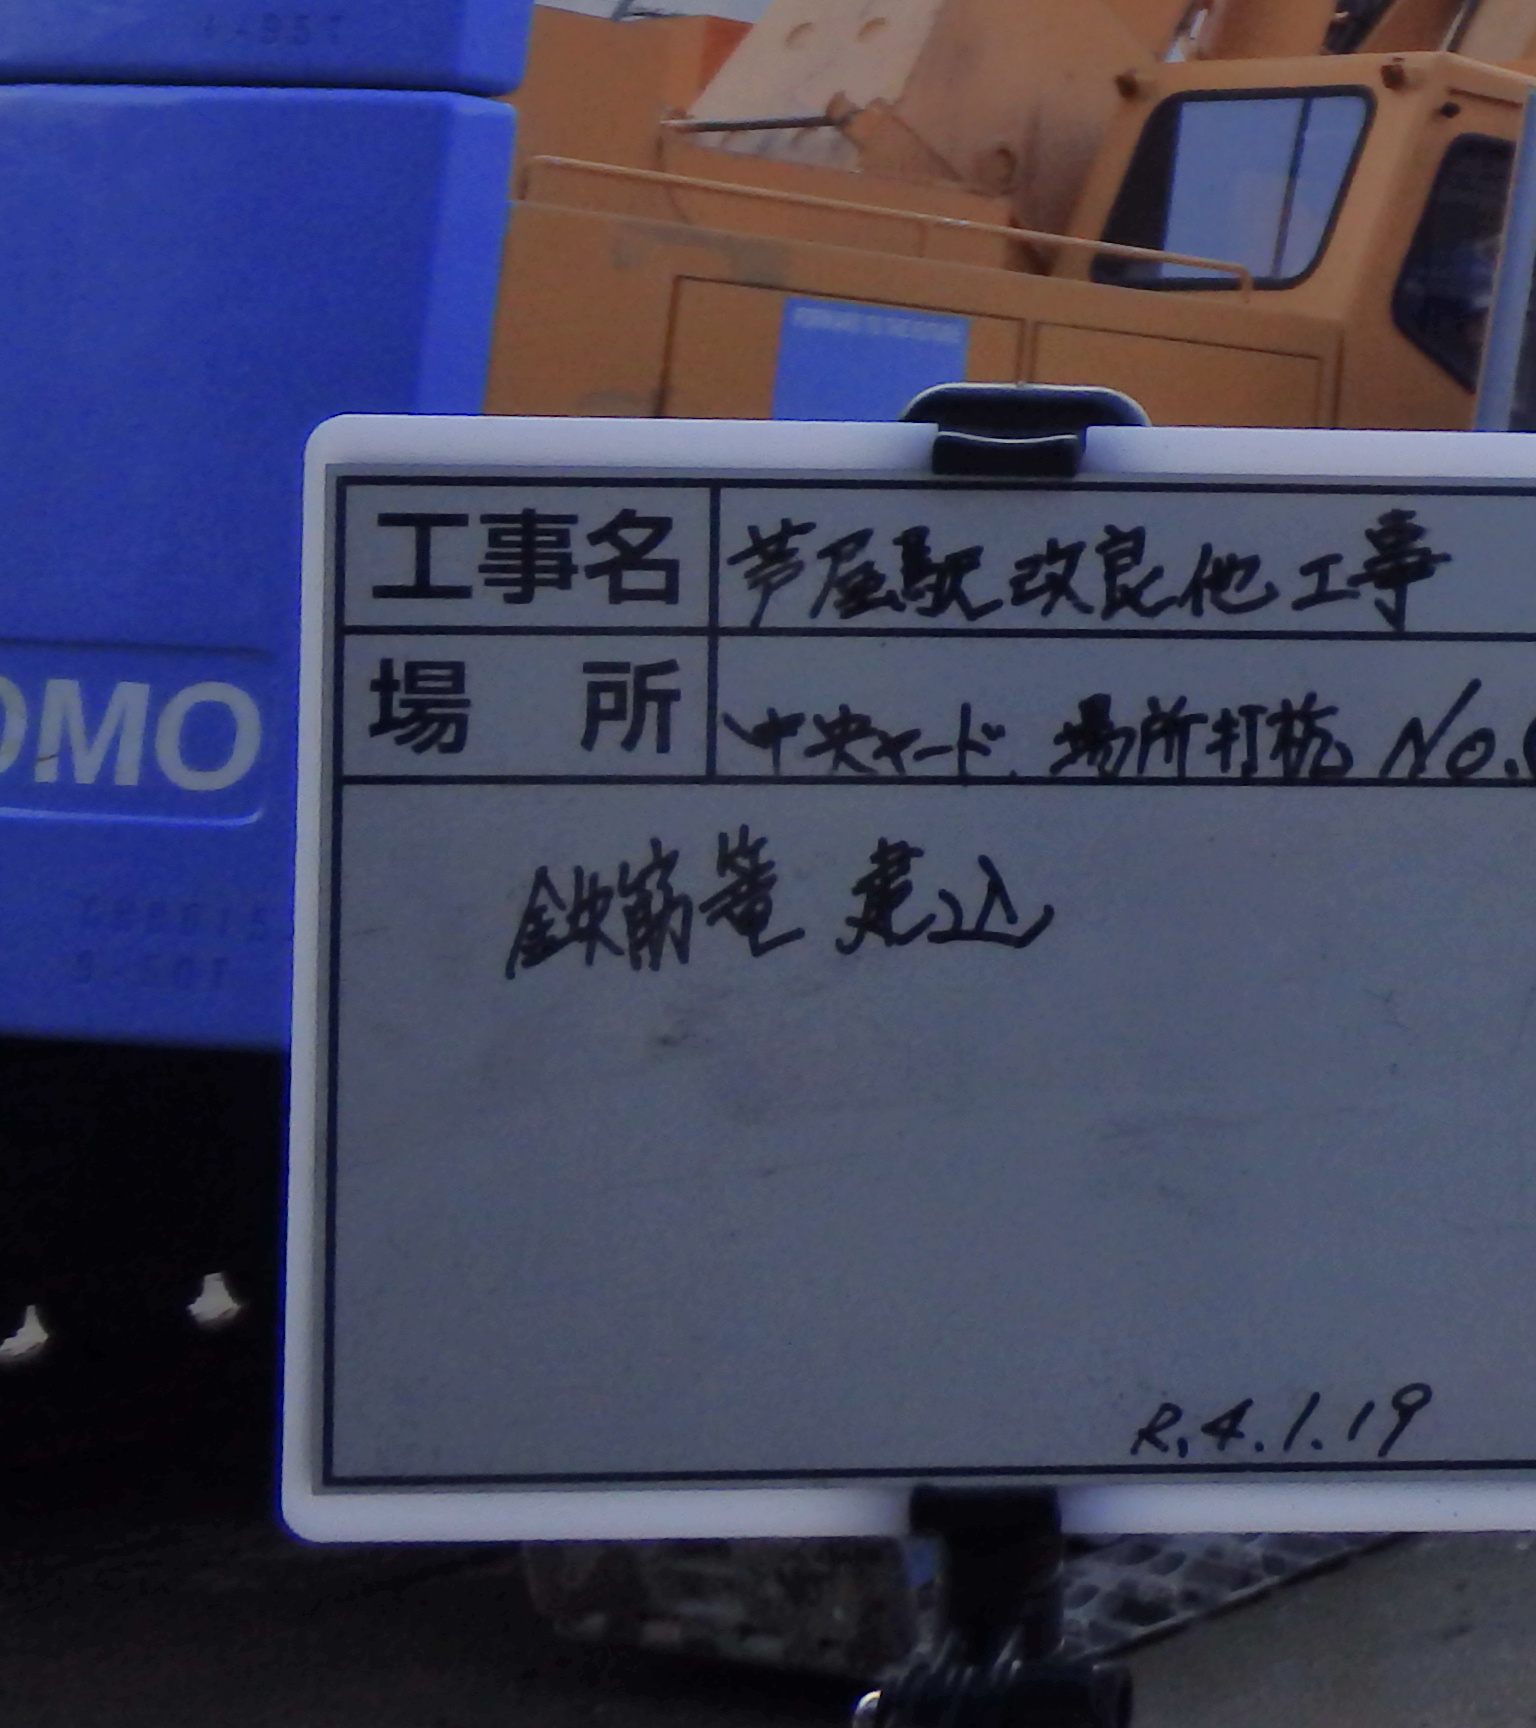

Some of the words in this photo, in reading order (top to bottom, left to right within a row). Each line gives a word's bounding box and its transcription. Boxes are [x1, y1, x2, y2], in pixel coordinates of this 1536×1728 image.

[372, 508, 680, 605] 工事名
[0, 675, 261, 791] MO
